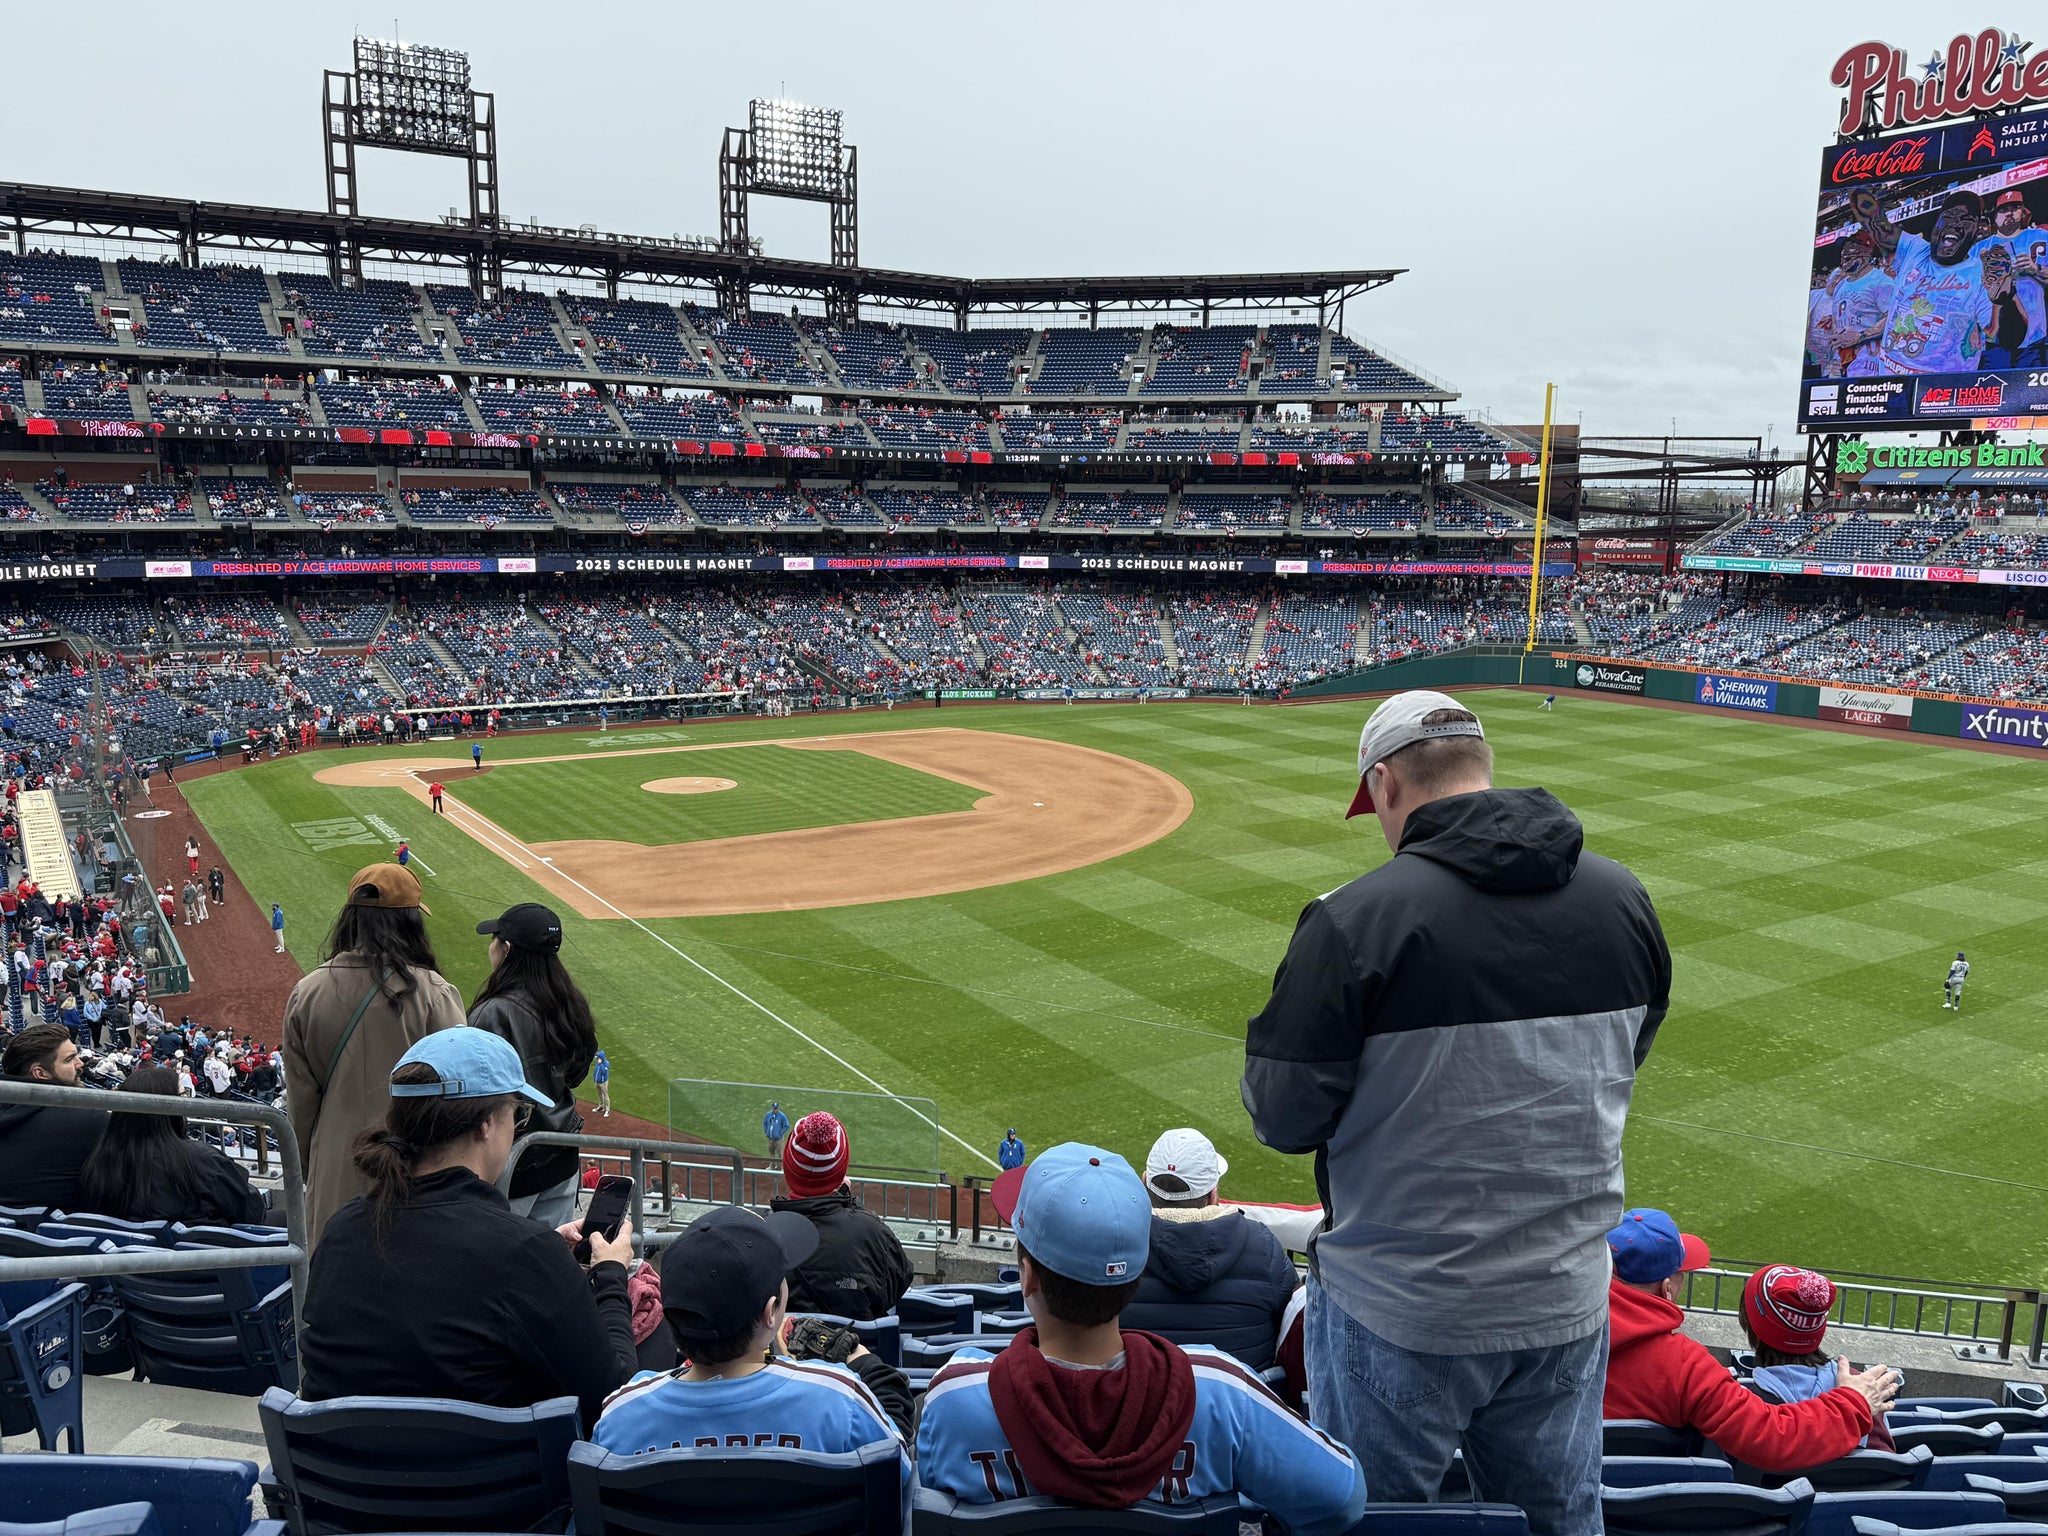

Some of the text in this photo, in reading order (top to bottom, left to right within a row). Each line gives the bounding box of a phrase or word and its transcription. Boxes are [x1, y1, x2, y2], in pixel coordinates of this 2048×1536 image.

[2002, 121, 2037, 136] SALTZ
[2000, 133, 2047, 148] INJURY
[1832, 136, 1932, 182] Coca-Cola
[1847, 382, 1903, 394] Connecting
[1959, 387, 2000, 398] HOME
[1845, 393, 1888, 404] financial
[1921, 388, 1952, 401] ACE
[1957, 397, 1999, 406] SERVICES
[1844, 405, 1887, 415] services.
[178, 427, 341, 439] PHILADELPHIA
[548, 439, 677, 451] PHILADELPHIA
[842, 450, 946, 460] PHILADELPHIA
[1097, 454, 1211, 463] PHILADELPHIA
[1382, 453, 1507, 463] PHILADELPHIA
[1873, 442, 2047, 468] Citizens Bank
[212, 560, 481, 574] PRESENTED BY ACE HARDWARE HOME SERVICES
[576, 559, 753, 570] 2025 SCHEDULE MAGNET
[827, 557, 1006, 569] PRESENTED BY ACE HARDWARE HOME SERVICES
[1081, 558, 1244, 571] 2025 SCHEDULE MAGNET
[1323, 563, 1373, 572] PRESENTED
[1375, 564, 1387, 572] BY
[1389, 564, 1408, 573] ACE
[1410, 564, 1463, 574] HARDWARE
[1465, 564, 1494, 574] HOME
[28, 565, 97, 578] MAGNET
[1839, 564, 1851, 574] 98
[1856, 565, 1926, 578] POWER ALLEY
[1930, 569, 1961, 580] NECA
[2006, 573, 2047, 583] LISCIO
[1568, 654, 1601, 662] ASPLUNDH
[1607, 658, 1643, 667] ASPLUNDH
[1650, 662, 1687, 672] ASPLUNDH
[1694, 667, 1734, 677] ASPLUNDH
[1595, 667, 1644, 684] NovaCare
[1741, 672, 1782, 682] ASPLUNDH
[1594, 680, 1641, 692] REHABILITATION
[1717, 678, 1768, 696] SHERWIN
[1790, 678, 1834, 688] ASPLUNDH
[1841, 683, 1887, 694] ASPLUNDH
[928, 690, 993, 698] GLLO'S PICKLES
[1896, 689, 1945, 700] ASPLUNDH
[1716, 691, 1769, 709] WILLIAMS.
[1836, 690, 1895, 711] Yuengling
[1953, 695, 2005, 707] ASPLUNDH
[2015, 702, 2048, 712] ASPLU
[1844, 711, 1882, 724] LAGER
[57, 1373, 63, 1383] 4
